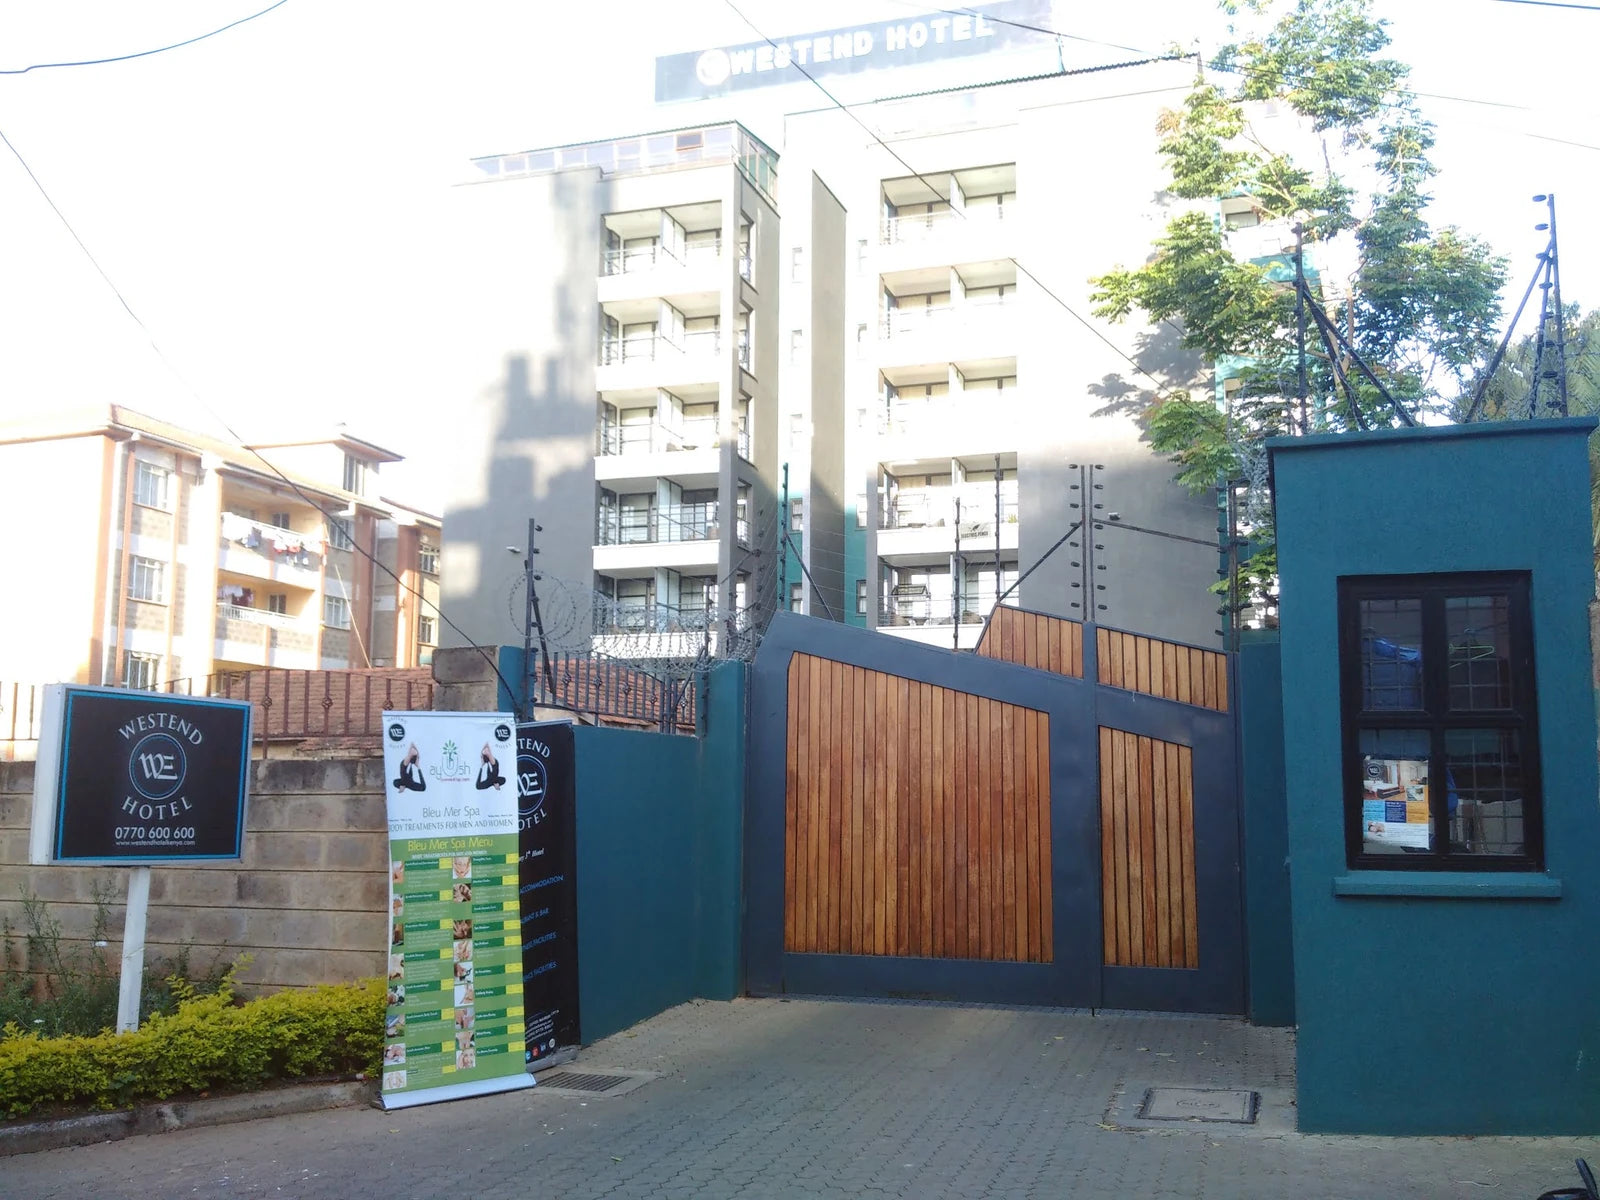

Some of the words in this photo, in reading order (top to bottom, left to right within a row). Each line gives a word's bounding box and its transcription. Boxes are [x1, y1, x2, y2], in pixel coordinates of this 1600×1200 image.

[729, 31, 874, 75] WESTEND
[886, 13, 995, 52] HOTEL
[118, 712, 203, 745] WESTEND
[517, 737, 551, 758] TEND
[121, 796, 193, 821] HOTEL
[422, 807, 441, 818] Bleu
[443, 807, 461, 817] Mer
[463, 805, 480, 819] Spa
[518, 807, 547, 831] OTEL
[115, 827, 145, 839] 0770
[148, 827, 170, 839] 600
[173, 827, 195, 839] 600
[405, 822, 444, 831] TREATMENTS
[445, 821, 458, 829] FOR
[459, 820, 473, 829] MEN
[474, 820, 488, 828] AND
[488, 818, 514, 827] WOMEN
[407, 840, 426, 852] Bleu
[429, 839, 448, 850] Mer
[450, 838, 465, 850] Spa
[468, 837, 493, 847] Menu
